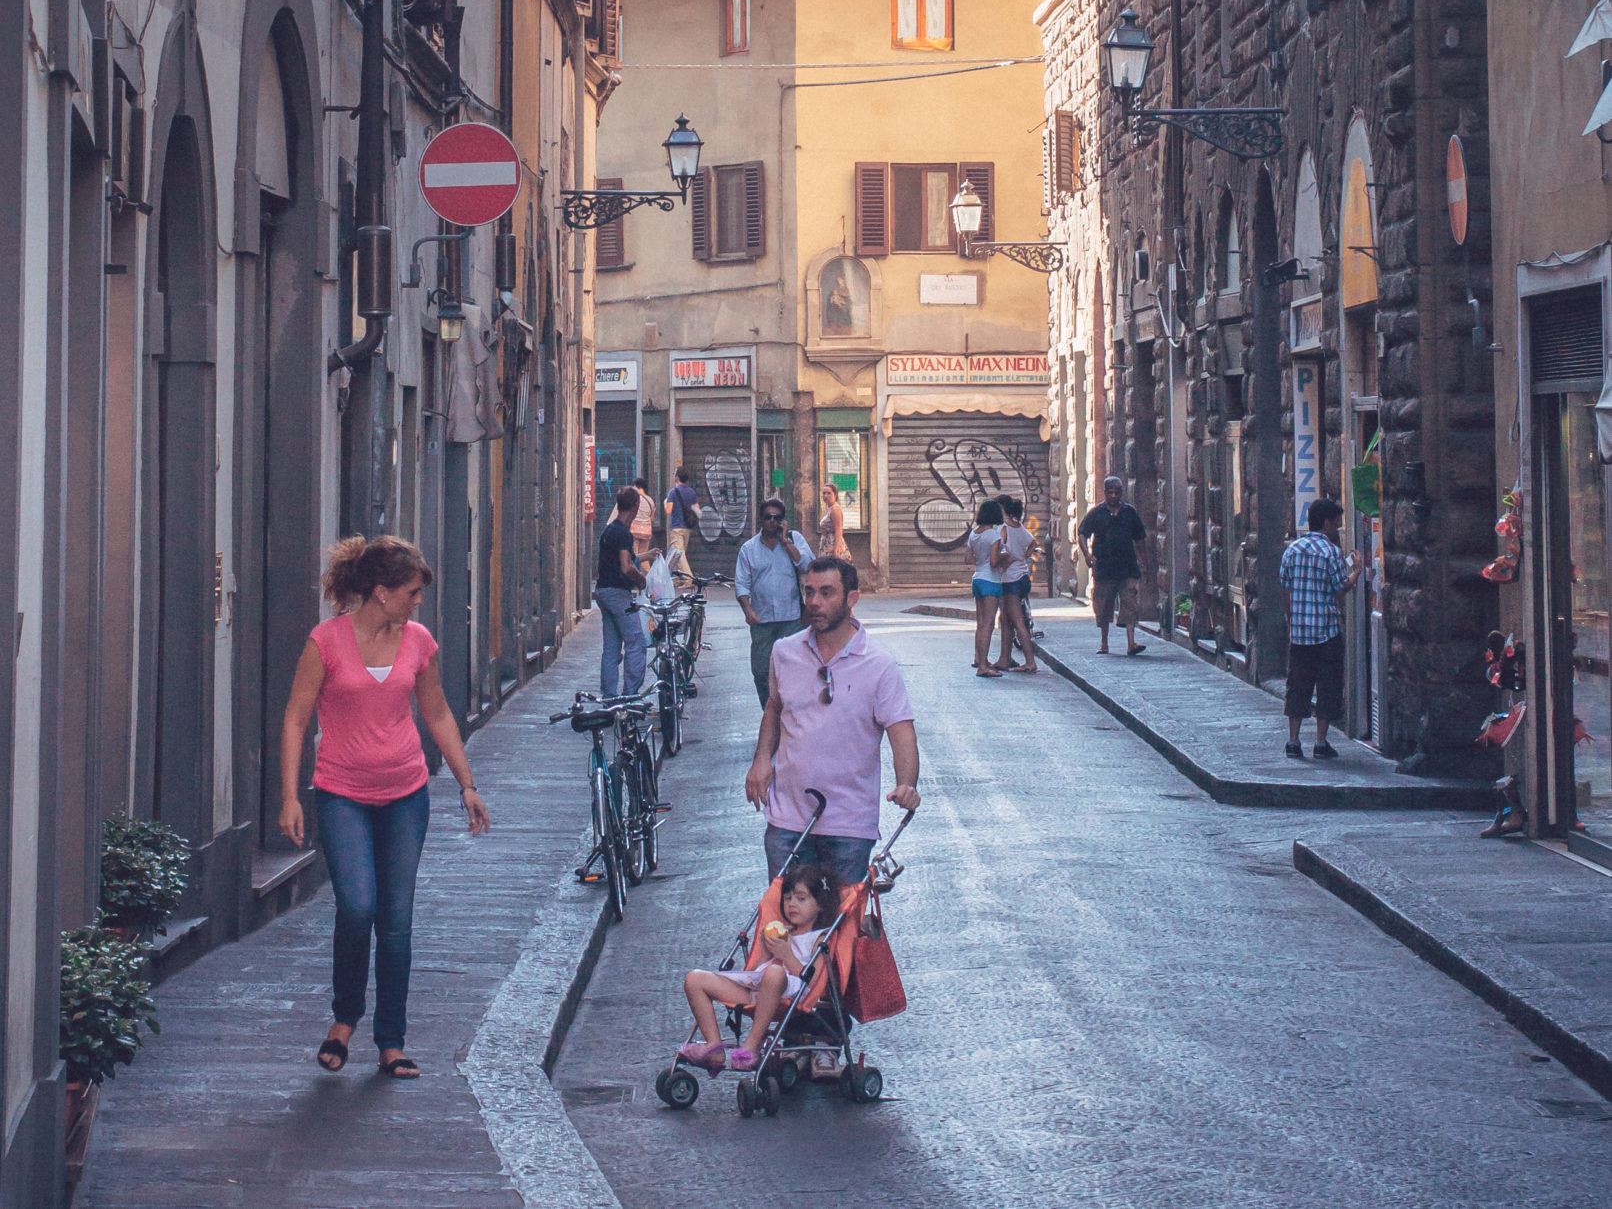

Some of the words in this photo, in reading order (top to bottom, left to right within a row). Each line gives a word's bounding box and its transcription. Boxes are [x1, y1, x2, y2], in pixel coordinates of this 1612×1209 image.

[674, 360, 707, 378] LOEWE
[717, 359, 741, 373] MAX
[889, 357, 965, 372] SYLVANIA
[969, 357, 1003, 372] MAX
[1005, 357, 1048, 372] NEON
[713, 372, 745, 386] NEON
[1297, 367, 1316, 527] PIZZA
[584, 448, 592, 481] SNACK
[584, 484, 592, 504] BAR
